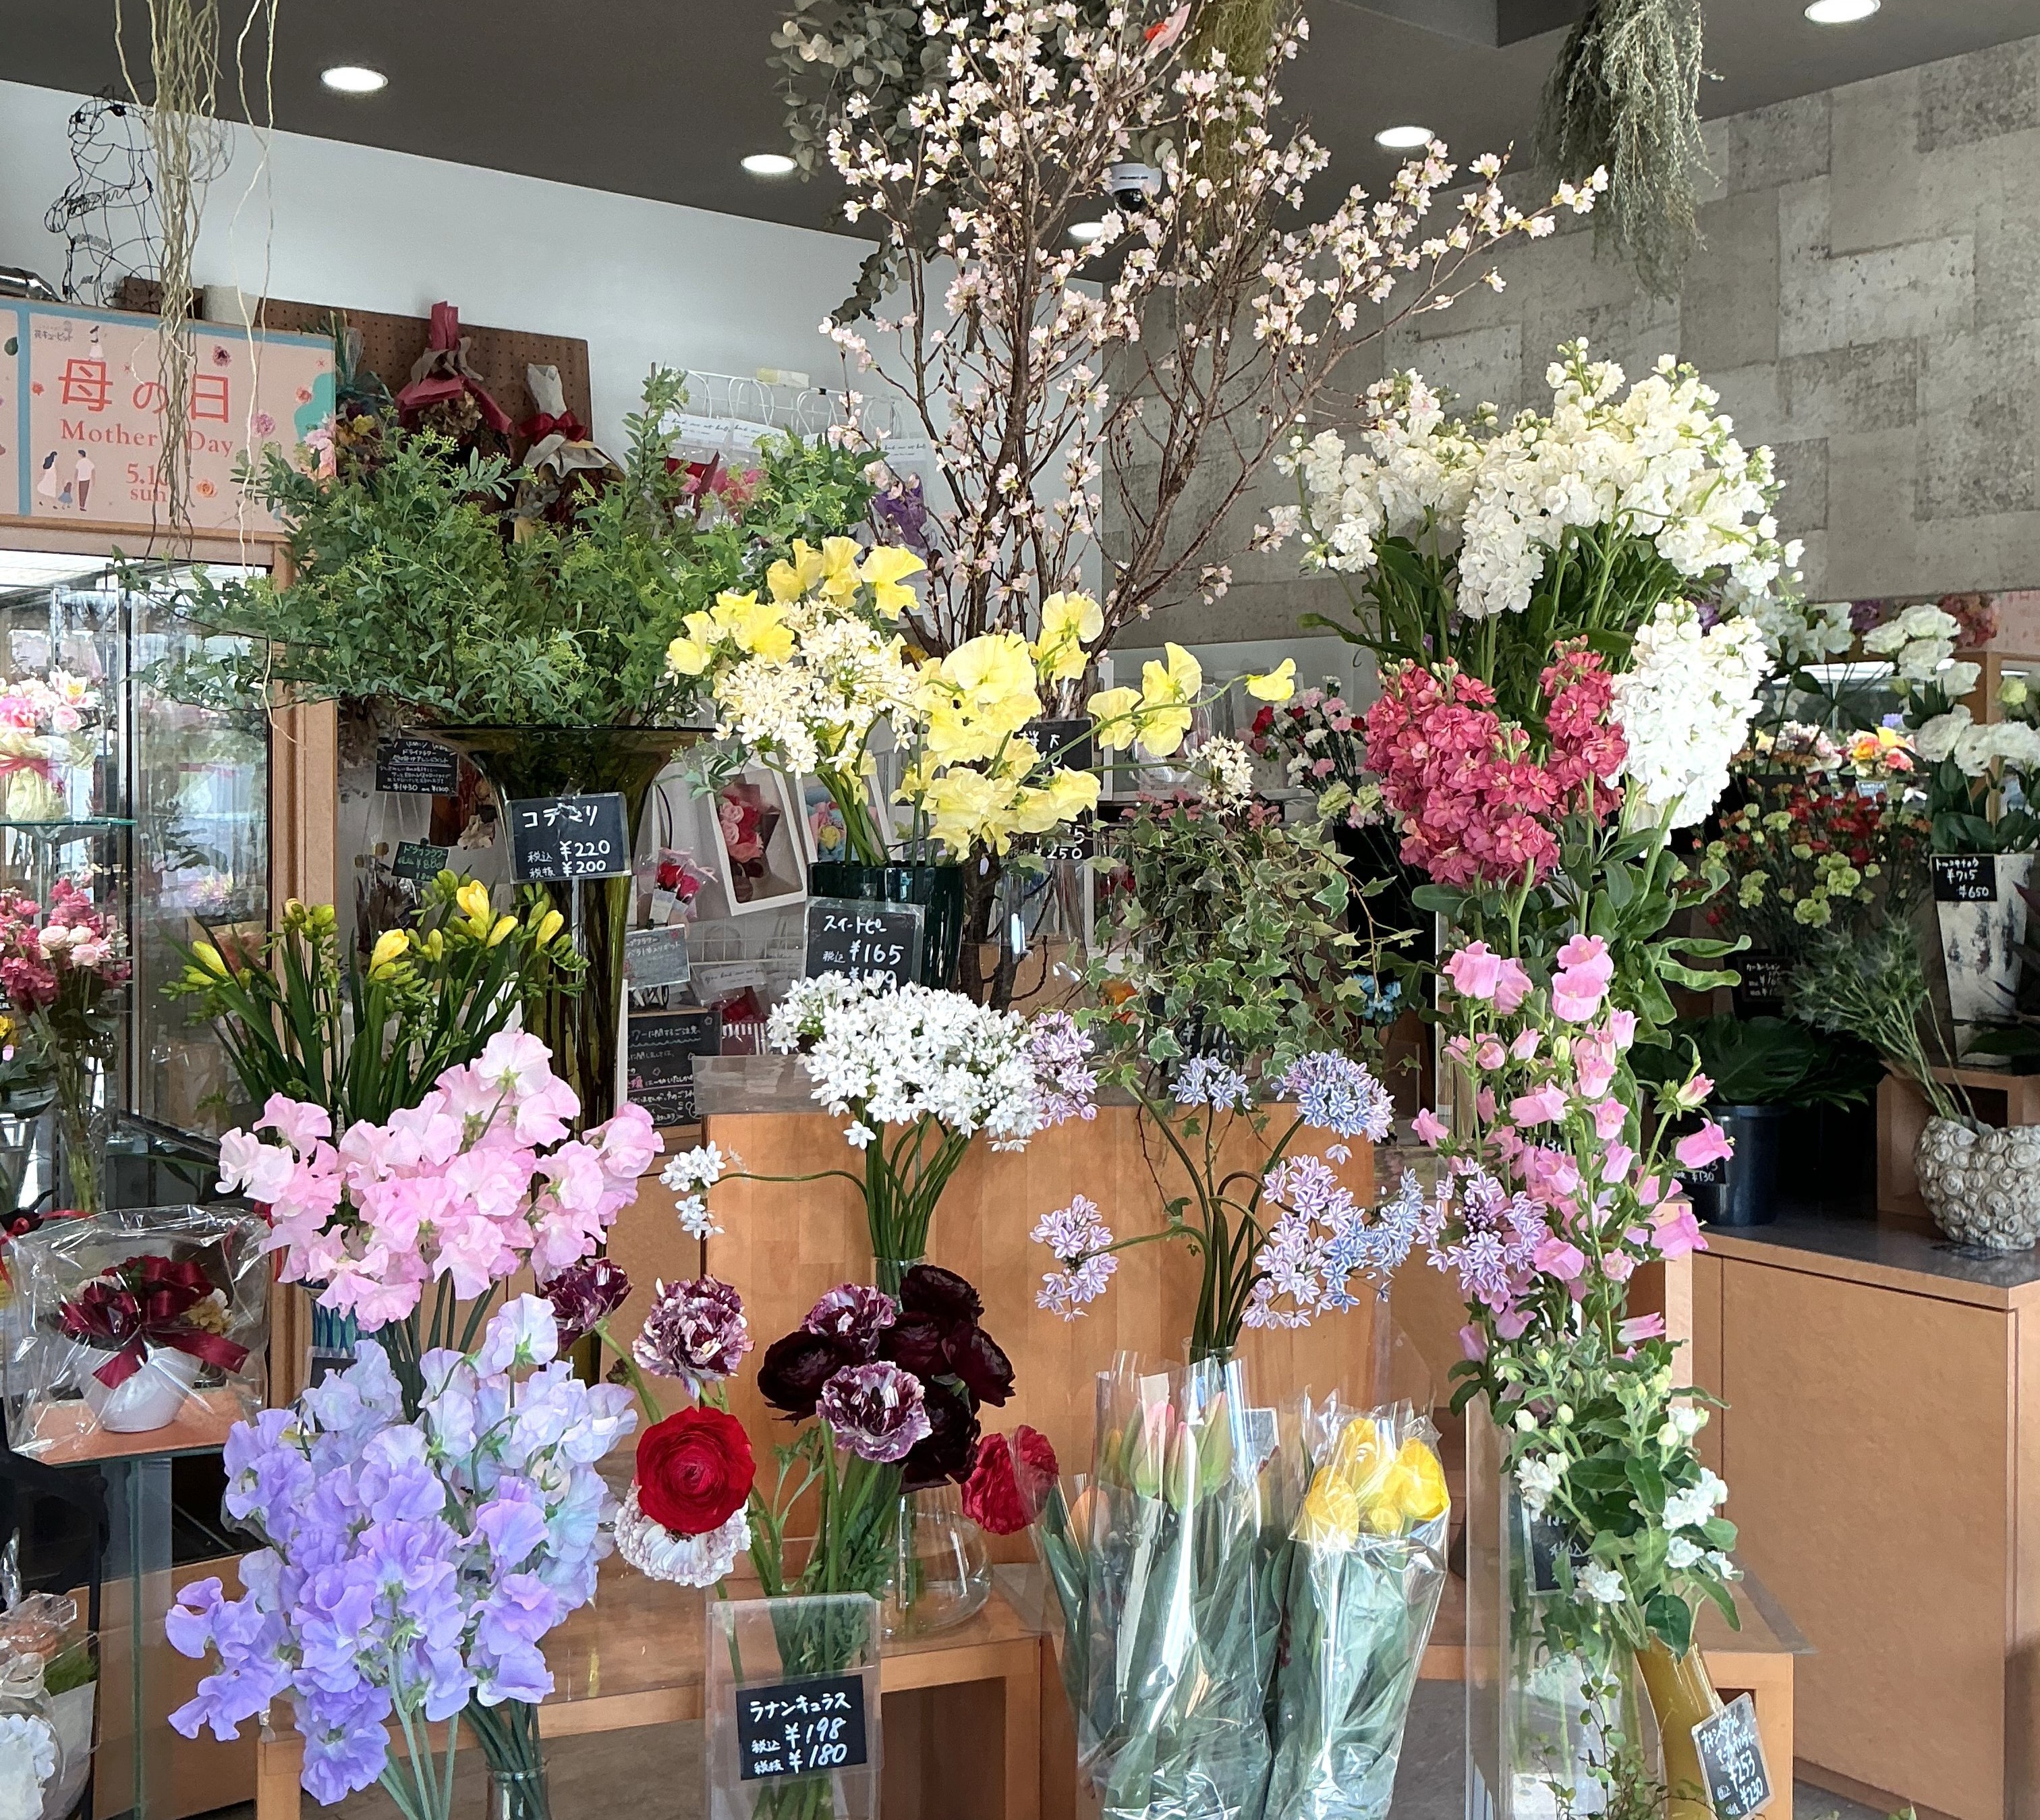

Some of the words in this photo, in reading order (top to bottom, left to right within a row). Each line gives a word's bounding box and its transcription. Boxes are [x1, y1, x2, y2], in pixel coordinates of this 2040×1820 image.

[58, 358, 229, 423] 母の日
[186, 430, 233, 457] Day
[131, 488, 167, 502] sun
[559, 839, 611, 861] ¥220
[561, 860, 606, 877] ¥200
[1947, 868, 1978, 884] ¥715
[1959, 884, 1989, 899] ¥650
[823, 915, 887, 935] スイートピー
[849, 940, 904, 965] ¥165
[750, 1692, 852, 1723] ラナンキュラス
[785, 1716, 847, 1749] ¥198
[789, 1743, 847, 1774] ¥180
[1727, 1750, 1755, 1792] ¥253
[1739, 1777, 1763, 1812] ¥230
